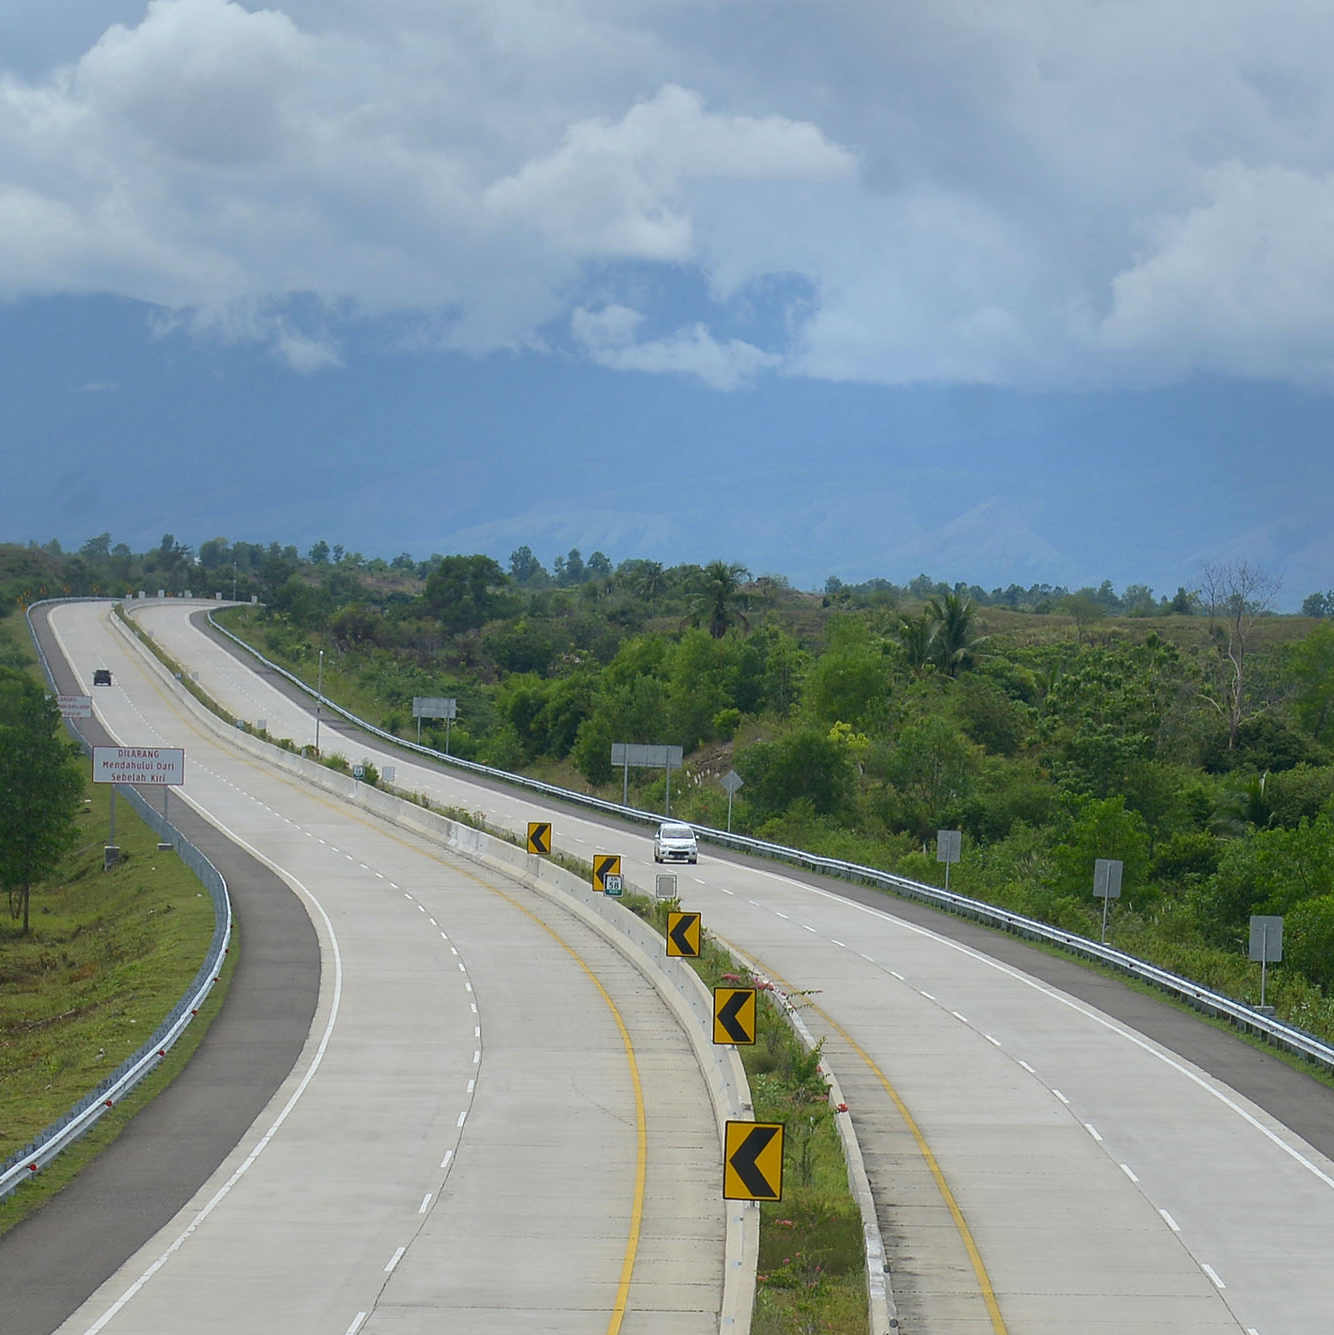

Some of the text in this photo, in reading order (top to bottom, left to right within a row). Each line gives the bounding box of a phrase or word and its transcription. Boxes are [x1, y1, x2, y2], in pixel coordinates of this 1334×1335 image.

[118, 749, 159, 759] DILARANG
[102, 761, 174, 771] Mendahului Dari
[111, 773, 165, 782] Sebelah Kiri
